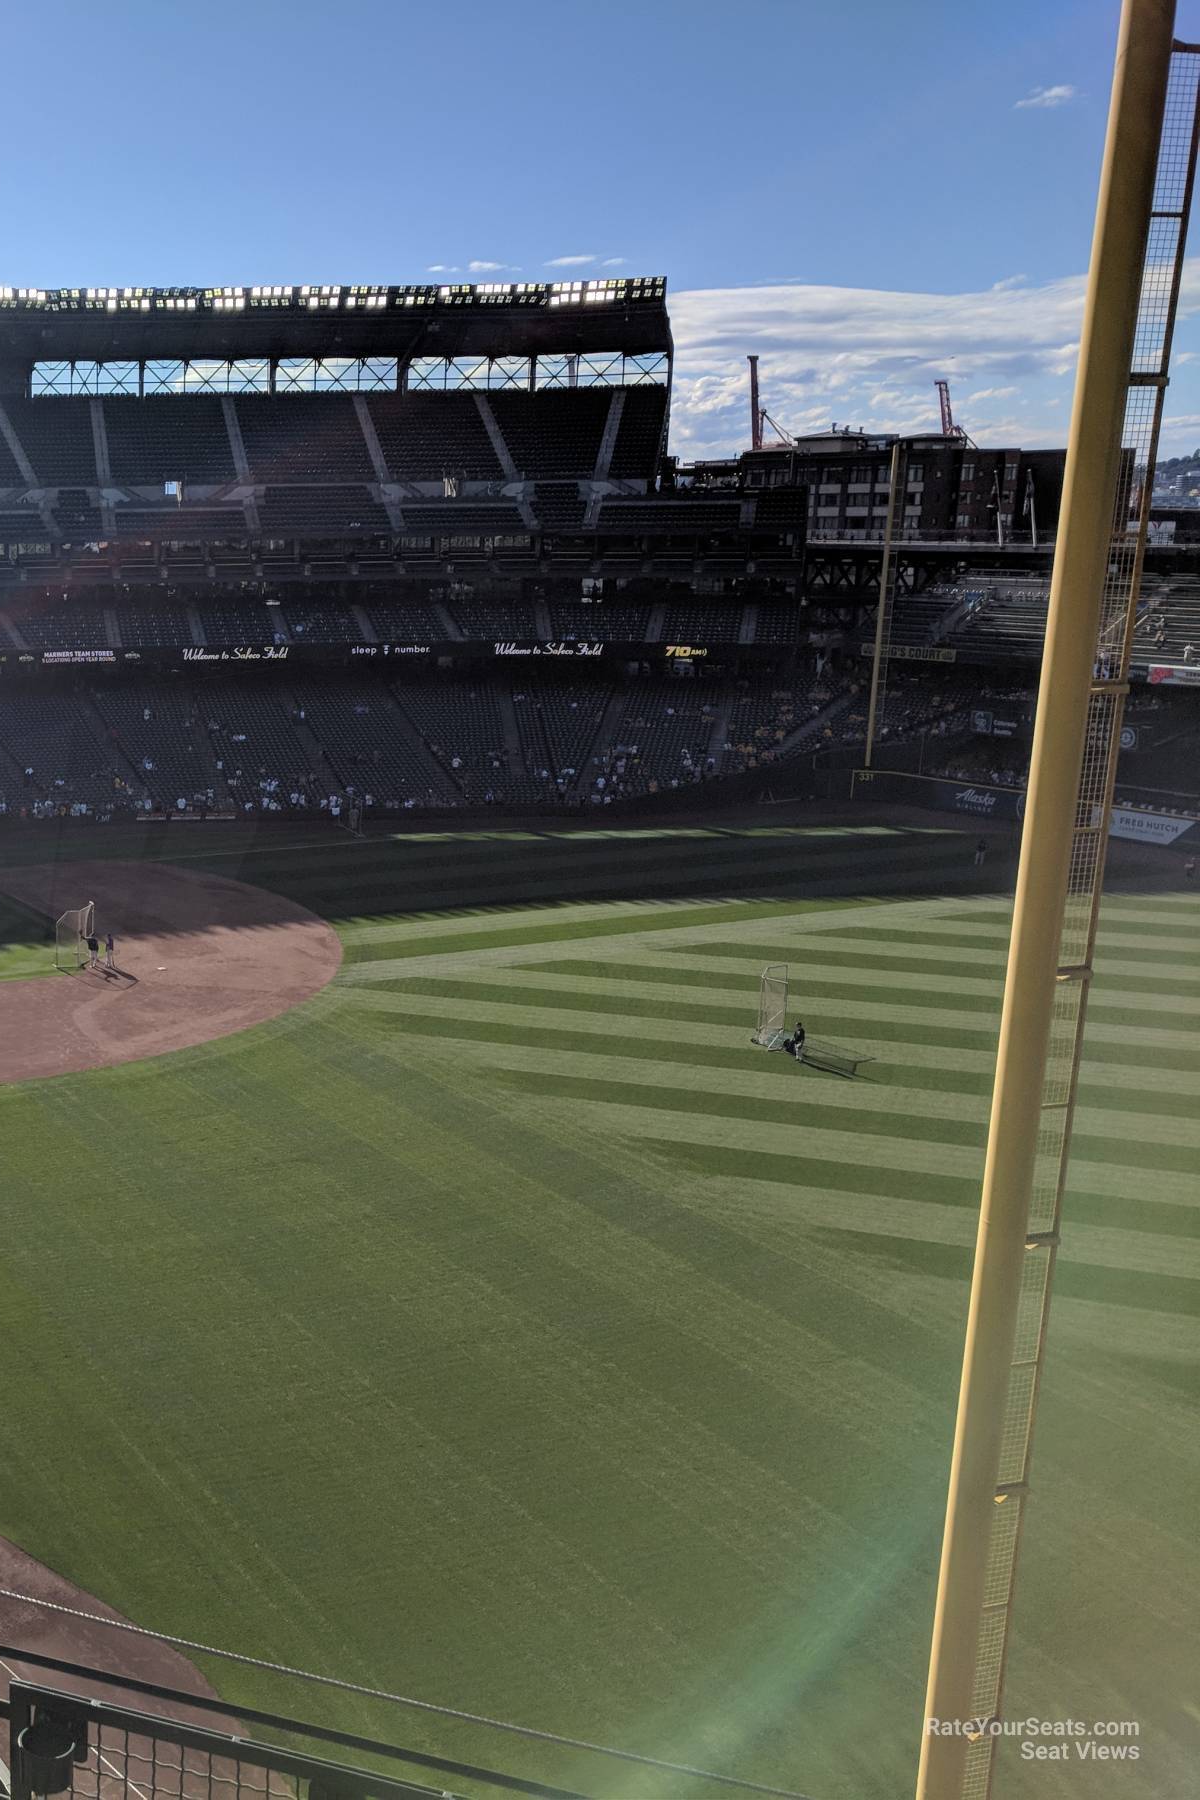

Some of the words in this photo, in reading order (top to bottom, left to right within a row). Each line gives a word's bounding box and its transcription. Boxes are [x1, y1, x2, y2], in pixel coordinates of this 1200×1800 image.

[182, 648, 220, 660] Welcome
[221, 651, 229, 660] to
[230, 647, 261, 660] Safeco
[262, 646, 289, 659] Field
[351, 645, 377, 656] sleep
[494, 643, 531, 655] Welcome
[533, 645, 541, 655] to
[542, 642, 574, 655] Safeco
[575, 642, 604, 655] Field
[955, 789, 996, 806] Alaska
[1119, 816, 1144, 828] FRED
[1146, 821, 1179, 833] HUTCH
